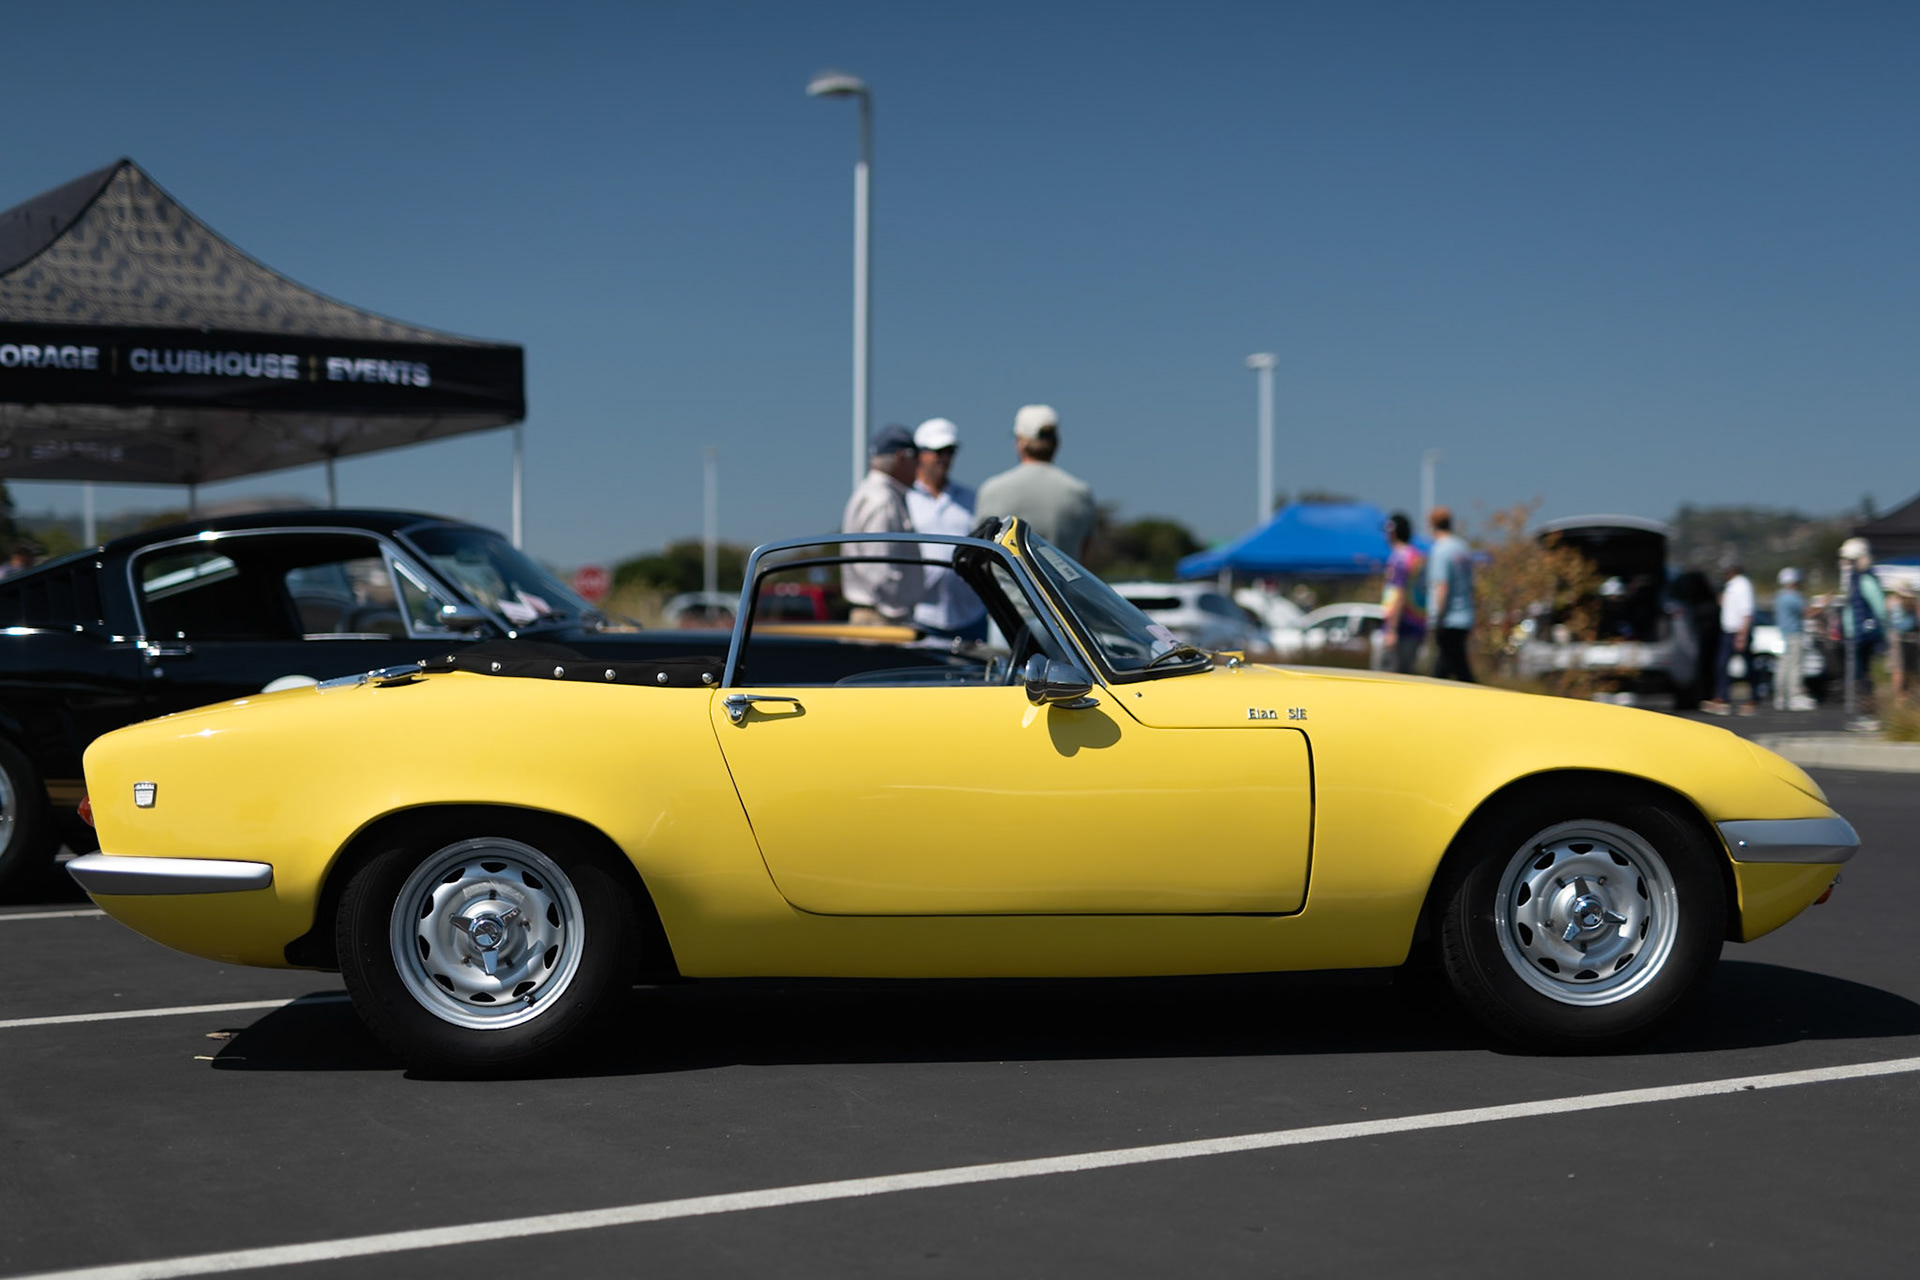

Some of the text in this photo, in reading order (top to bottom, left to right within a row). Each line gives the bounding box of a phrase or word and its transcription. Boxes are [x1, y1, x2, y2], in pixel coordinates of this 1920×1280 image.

[129, 348, 299, 380] CLUBHOUSE
[326, 356, 431, 387] EVENTS
[1247, 707, 1278, 720] Elan
